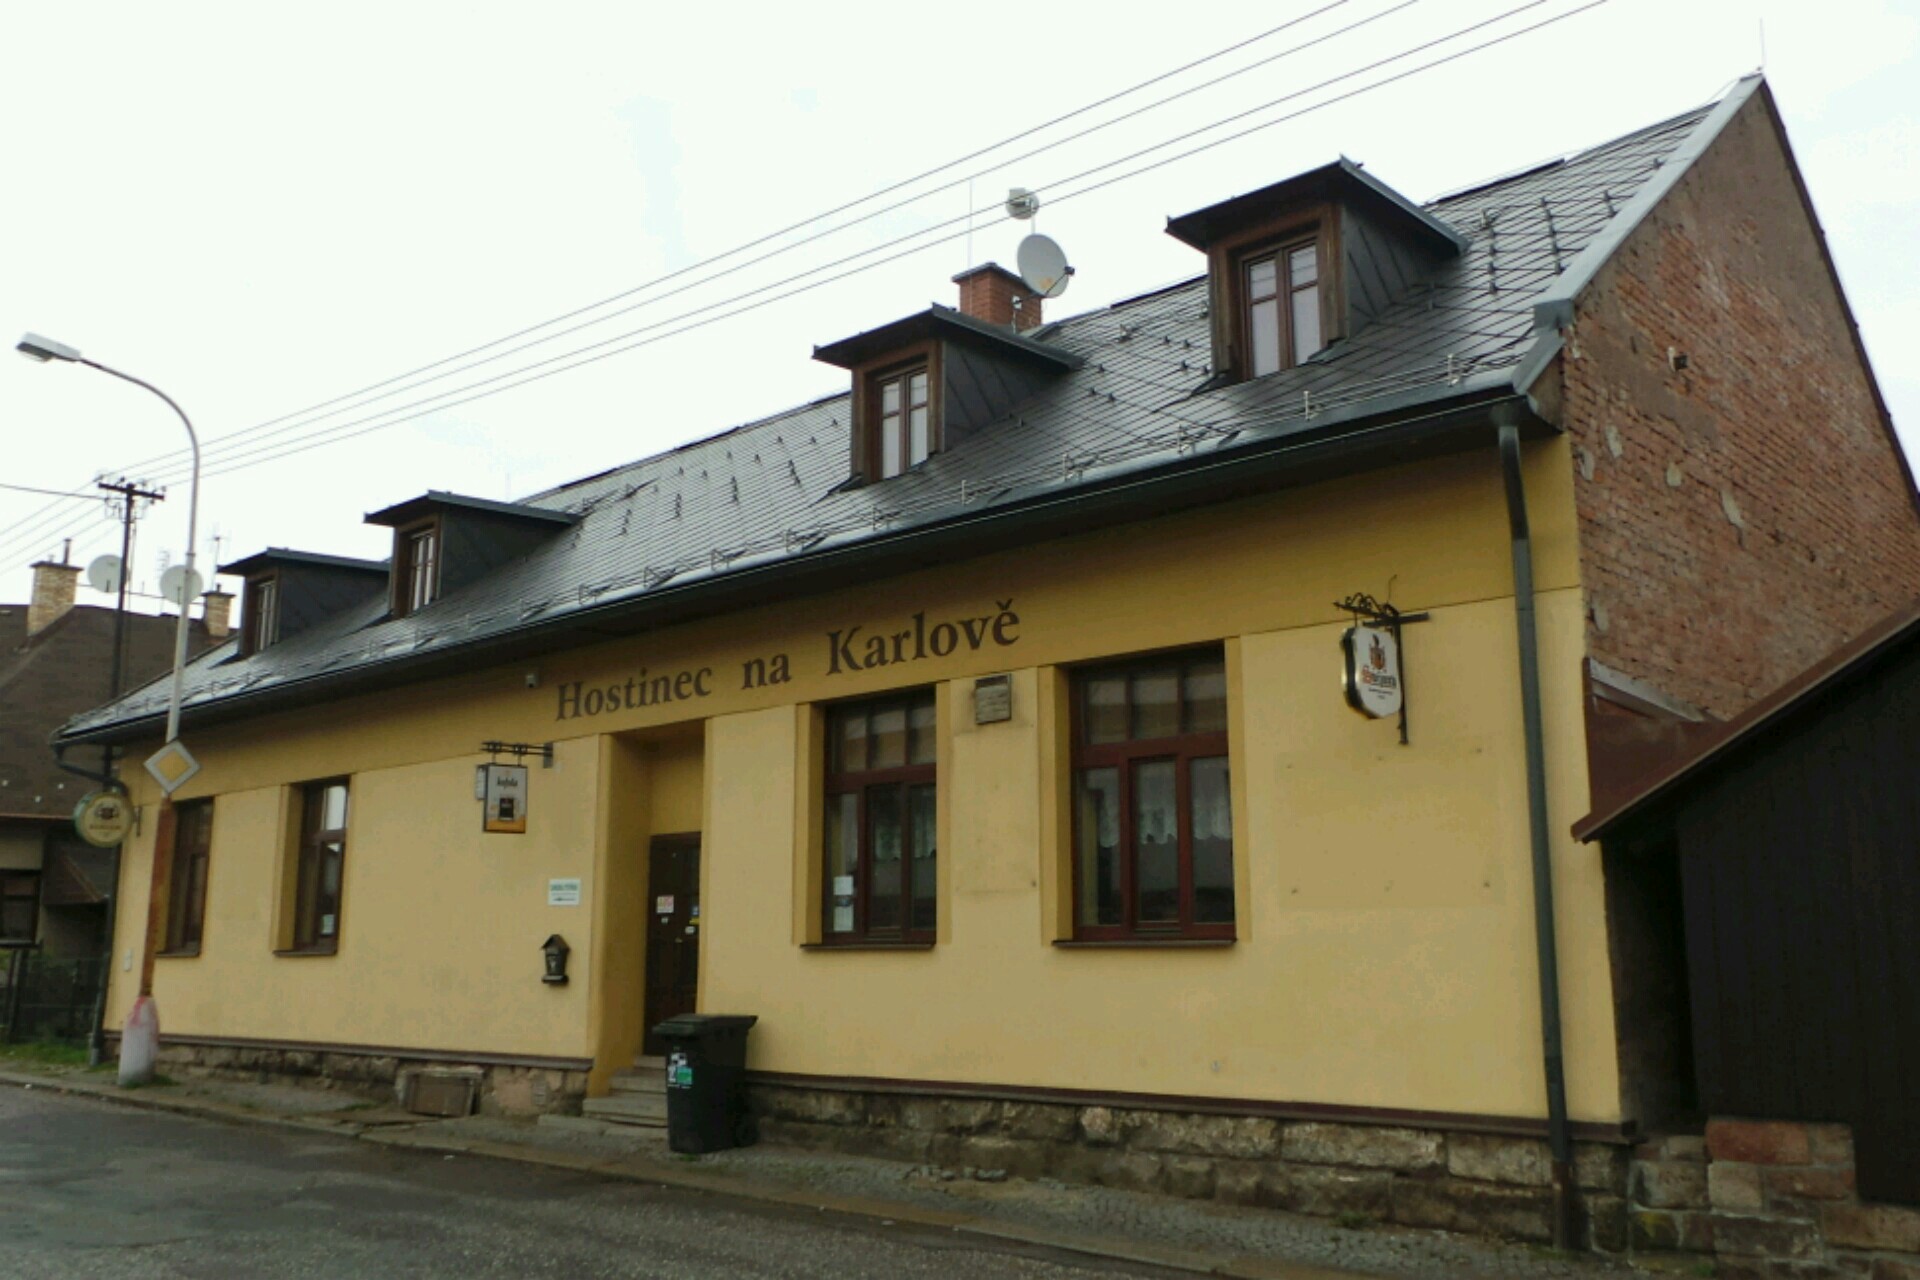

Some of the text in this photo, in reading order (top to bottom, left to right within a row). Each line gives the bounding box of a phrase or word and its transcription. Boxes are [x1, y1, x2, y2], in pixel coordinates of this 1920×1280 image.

[555, 598, 1020, 721] Hostinec na Karlově
